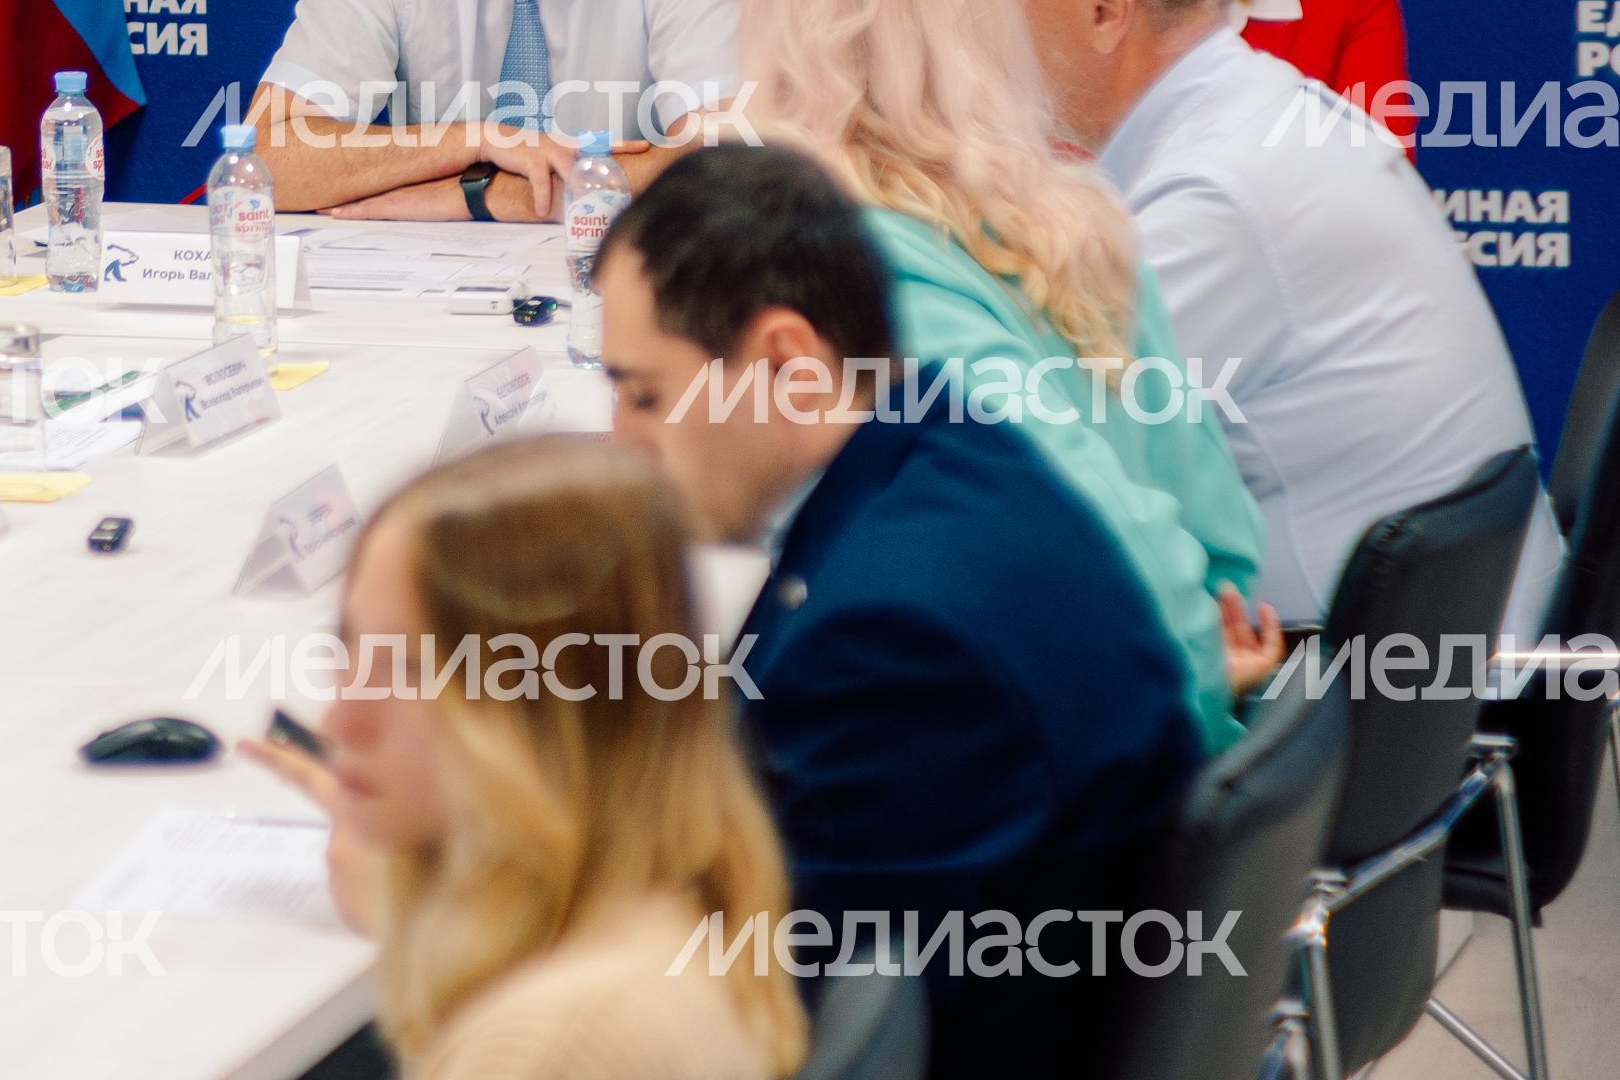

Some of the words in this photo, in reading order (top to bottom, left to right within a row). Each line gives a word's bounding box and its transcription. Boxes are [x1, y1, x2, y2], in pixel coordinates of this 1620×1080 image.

[1433, 189, 1569, 223] ИНАЯ
[573, 214, 609, 226] saint
[143, 268, 185, 281] Игорь
